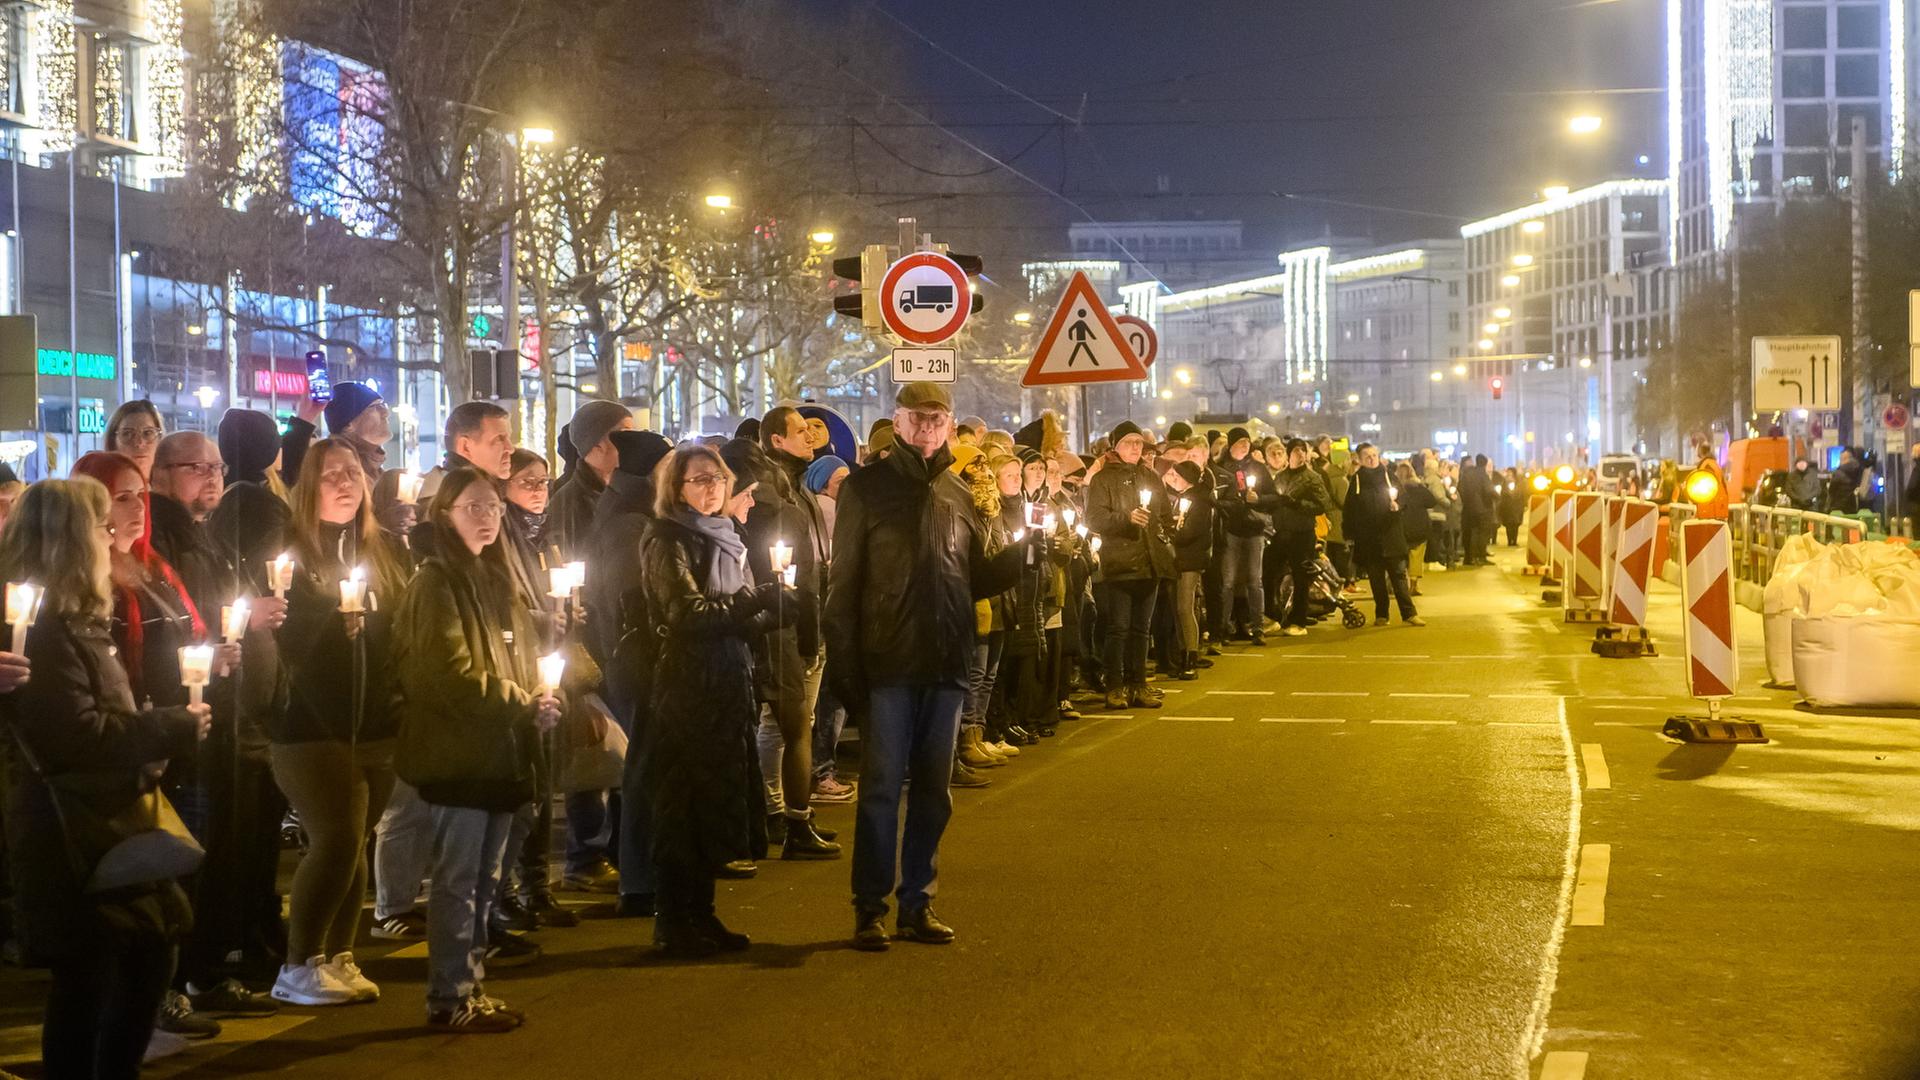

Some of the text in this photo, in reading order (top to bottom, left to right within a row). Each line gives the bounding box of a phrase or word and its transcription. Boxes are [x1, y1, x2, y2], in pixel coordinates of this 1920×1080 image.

[1769, 343, 1831, 352] Hauptbahnhof
[900, 359, 912, 373] 10
[928, 359, 950, 373] 23h
[254, 370, 306, 395] ROSMANN
